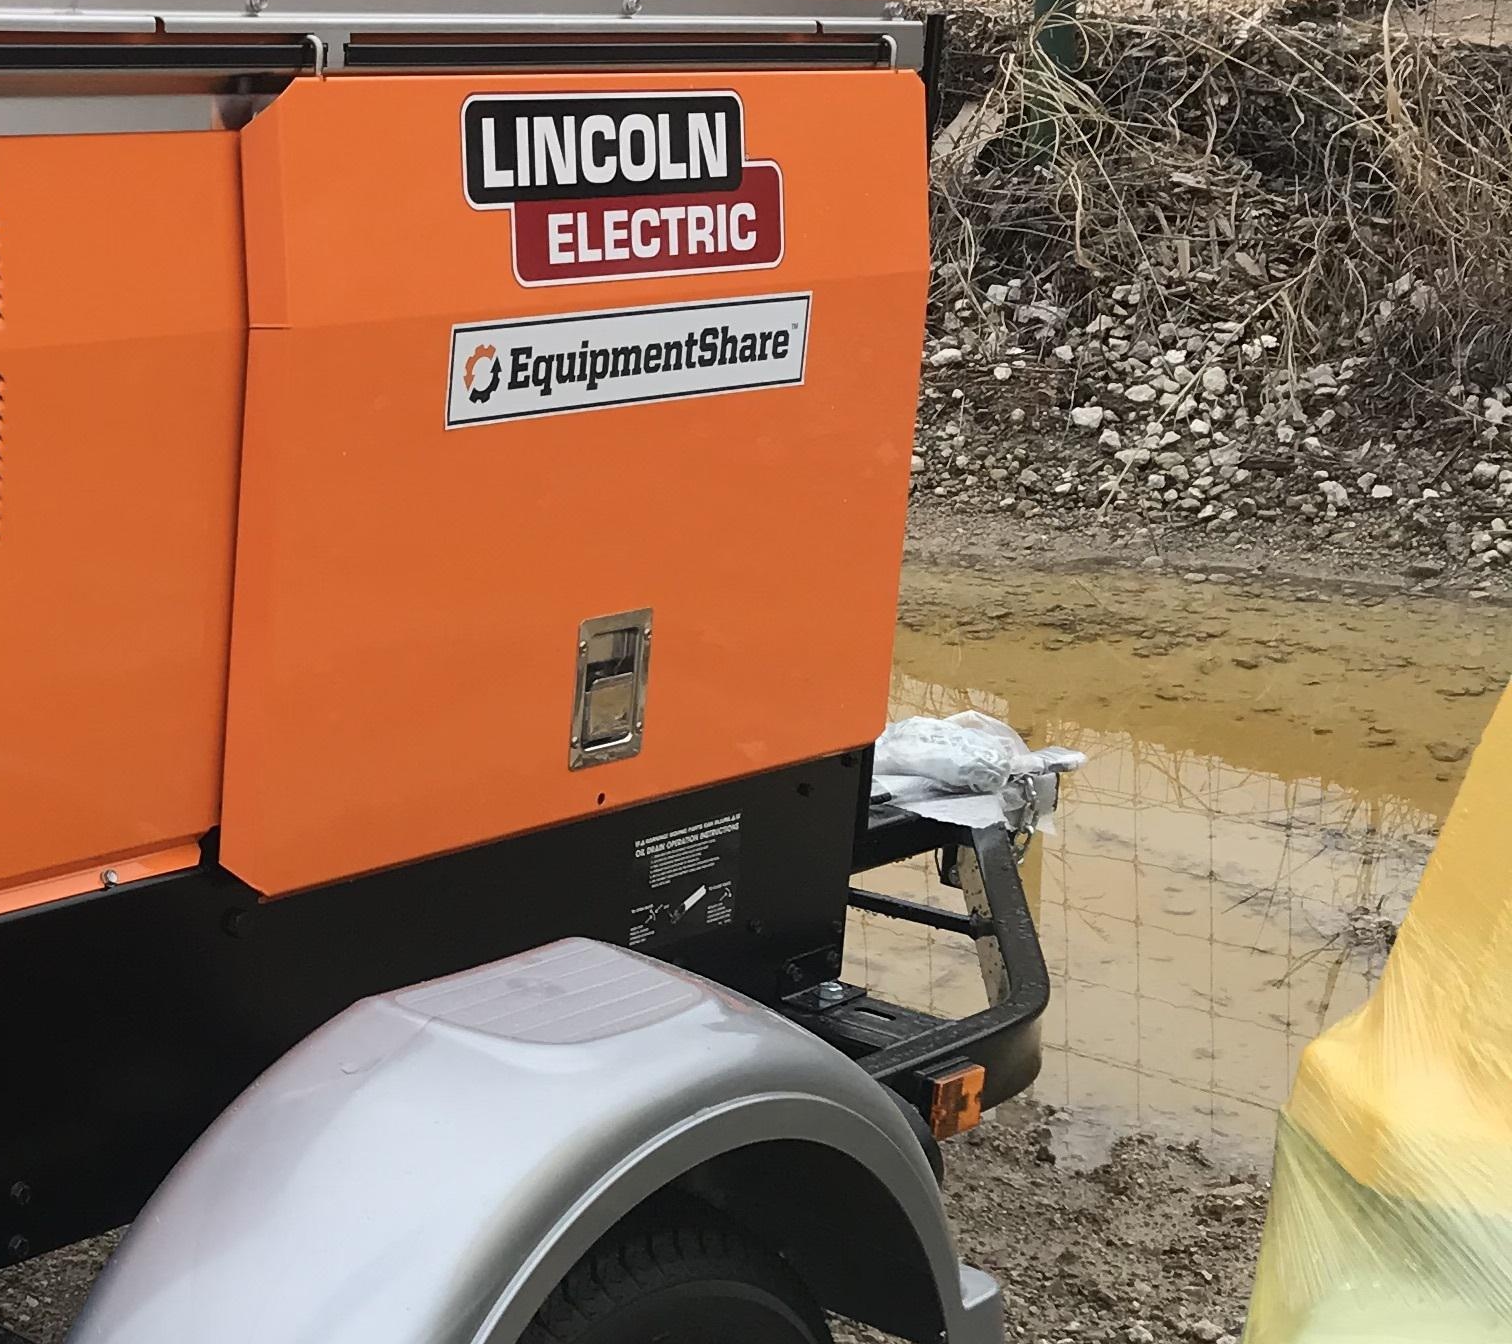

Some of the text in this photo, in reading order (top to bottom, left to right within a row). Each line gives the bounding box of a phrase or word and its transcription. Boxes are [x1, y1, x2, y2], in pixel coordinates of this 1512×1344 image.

[482, 112, 727, 188] LINCOLN
[548, 202, 757, 265] ELECTRIC
[508, 326, 790, 396] EquipmentShare
[666, 834, 699, 849] OPERATION
[699, 822, 740, 840] INSTRUCTIONS
